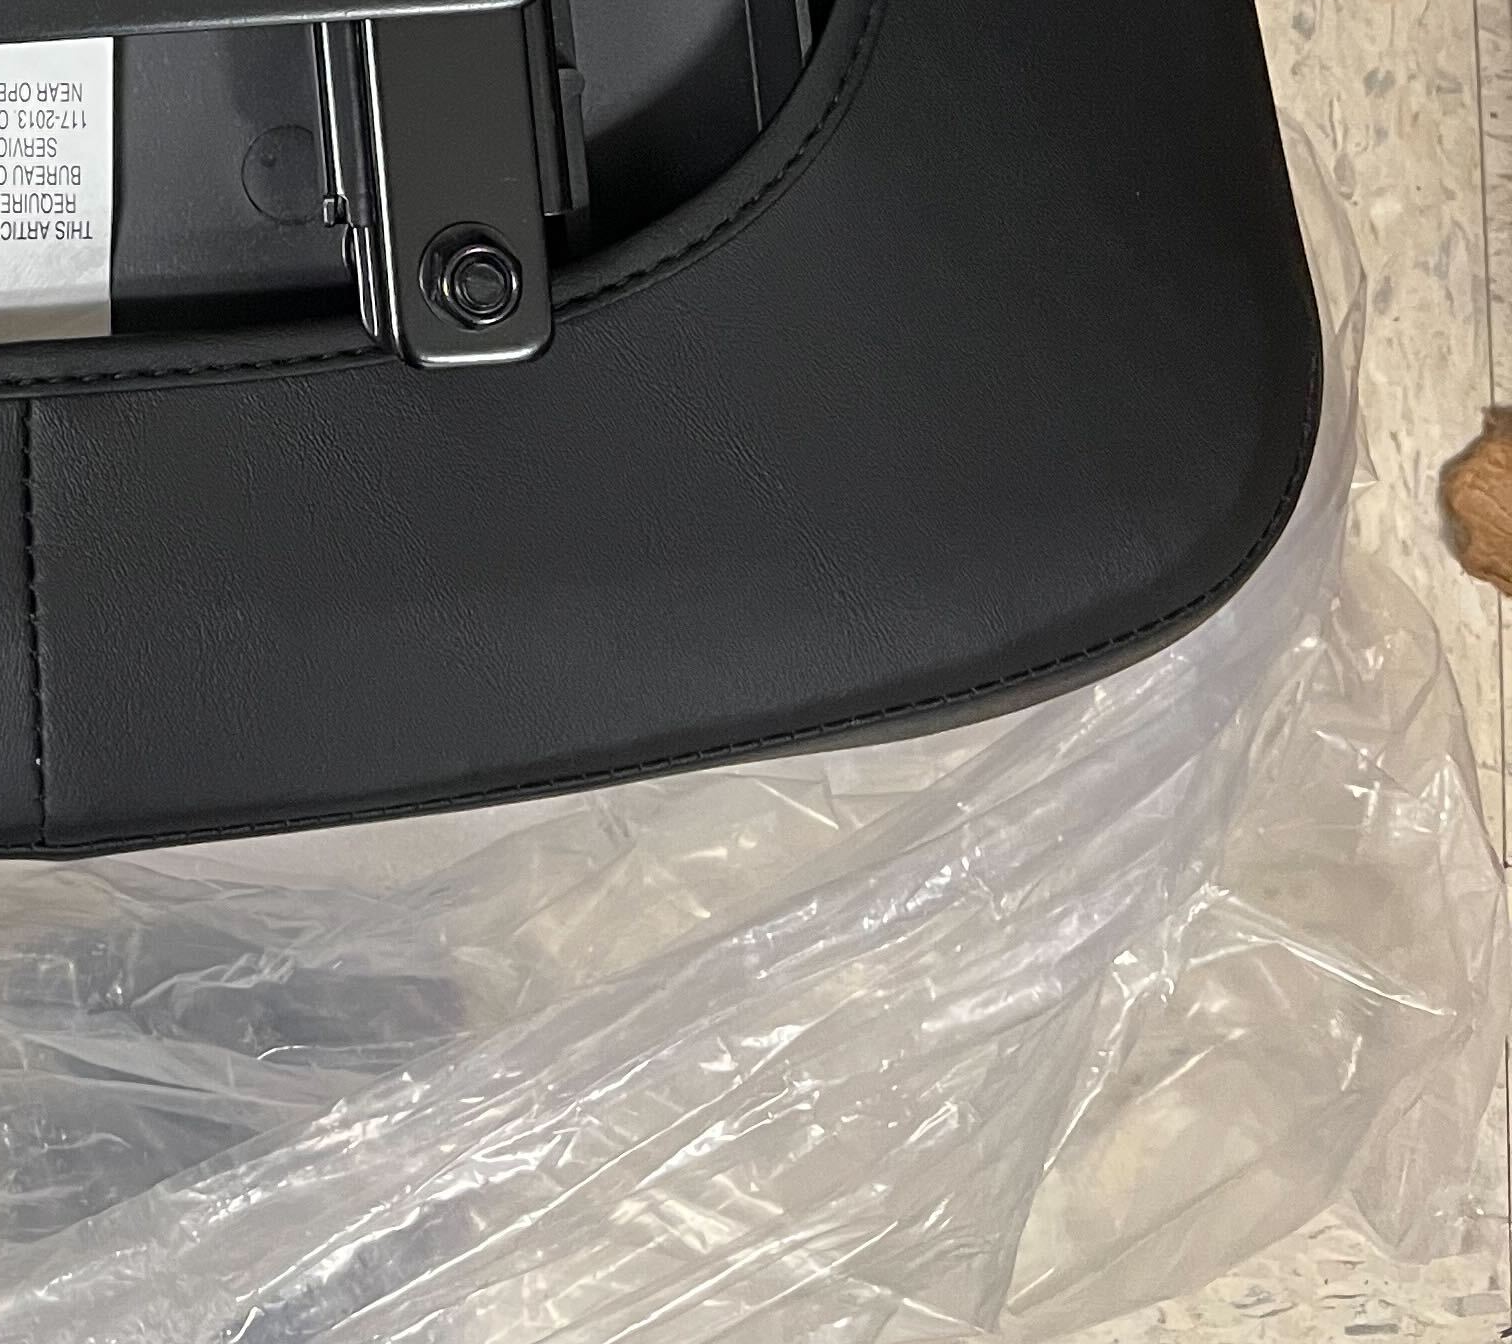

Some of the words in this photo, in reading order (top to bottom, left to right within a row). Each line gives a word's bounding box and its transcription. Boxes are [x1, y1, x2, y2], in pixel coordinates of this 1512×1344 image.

[37, 82, 83, 103] NEAR
[14, 109, 87, 130] 117-2013.
[13, 165, 81, 186] BUREAU
[55, 220, 93, 240] THIS
